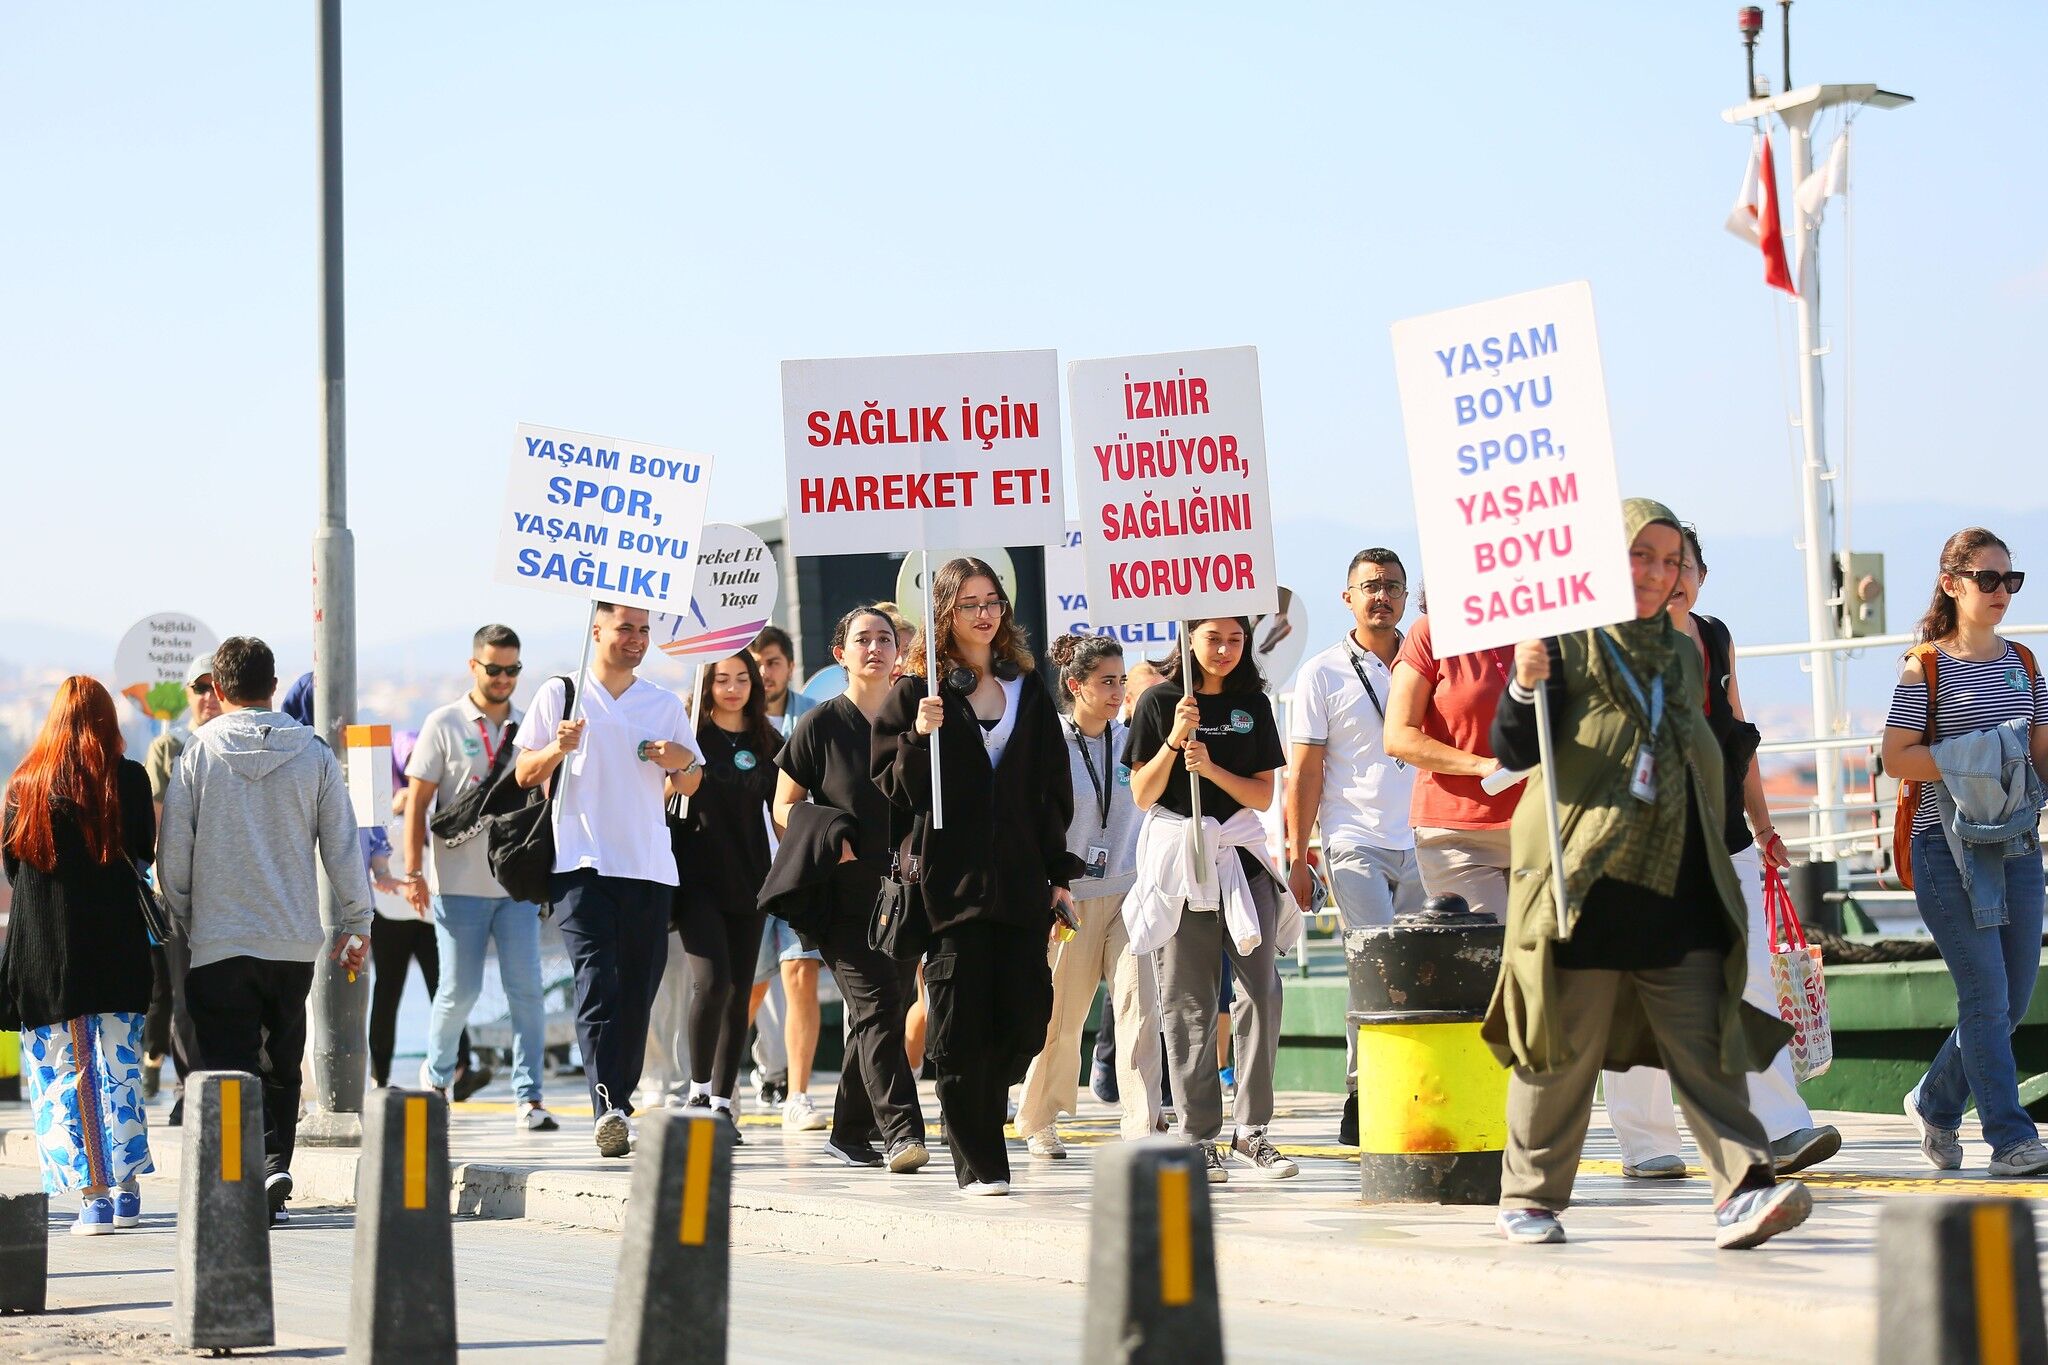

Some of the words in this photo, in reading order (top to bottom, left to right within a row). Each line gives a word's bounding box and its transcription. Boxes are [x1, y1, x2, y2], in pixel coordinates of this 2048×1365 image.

[1436, 322, 1559, 378] YAŞAM
[1124, 368, 1210, 420] İZMİR
[1454, 375, 1554, 426] BOYU
[807, 400, 949, 447] SAĞLIK
[961, 395, 1040, 450] İÇİN
[525, 436, 620, 470] YAŞAM
[629, 455, 701, 484] BOYU
[1093, 429, 1250, 482] YÜRÜYOR,
[1456, 427, 1566, 477] SPOR,
[547, 476, 663, 527] SPOR,
[800, 471, 979, 514] HAREKET
[992, 468, 1052, 506] ET!
[1101, 486, 1252, 542] SAĞLIĞINI
[1456, 472, 1580, 527] YAŞAM
[514, 512, 609, 546] YAŞAM
[618, 530, 689, 560] BOYU
[697, 549, 741, 566] reket
[744, 547, 763, 562] Et
[1473, 524, 1574, 575] BOYU
[517, 548, 672, 600] SAĞLIK!
[709, 568, 761, 587] Mutlu
[1109, 553, 1256, 600] KORUYOR
[1463, 571, 1597, 628] SAĞLIK
[721, 592, 759, 609] Yaşa
